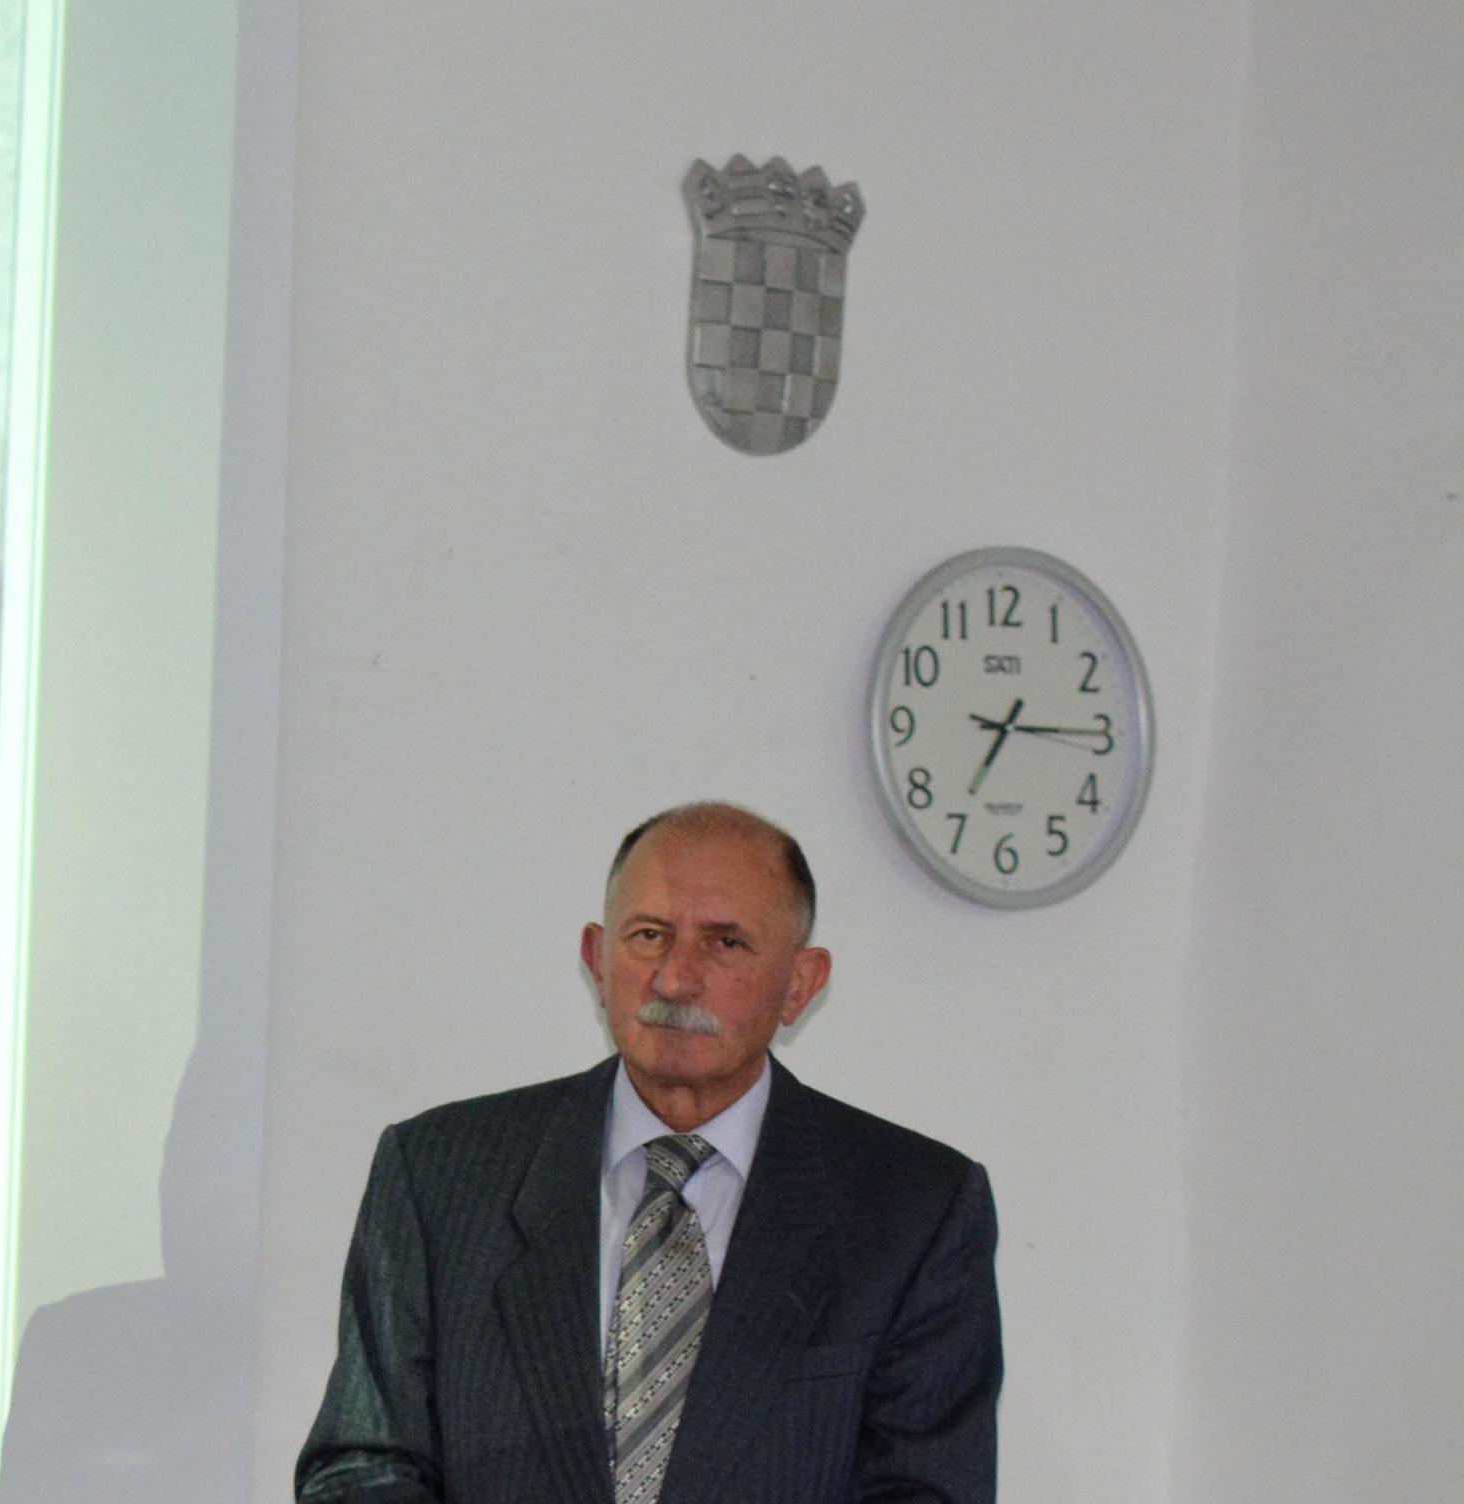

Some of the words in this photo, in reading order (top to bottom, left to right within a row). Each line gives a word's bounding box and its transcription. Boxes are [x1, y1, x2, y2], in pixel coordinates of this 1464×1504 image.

[940, 600, 968, 640] 11
[986, 585, 1023, 628] 12
[1048, 603, 1059, 644] 1
[903, 644, 940, 687] 10
[1079, 651, 1101, 693] 2
[890, 705, 916, 748] 9
[1092, 713, 1114, 755] 3
[907, 767, 933, 810] 8
[1075, 772, 1102, 815] 4
[945, 812, 968, 855] 7
[994, 831, 1020, 875] 6
[1045, 815, 1069, 857] 5
